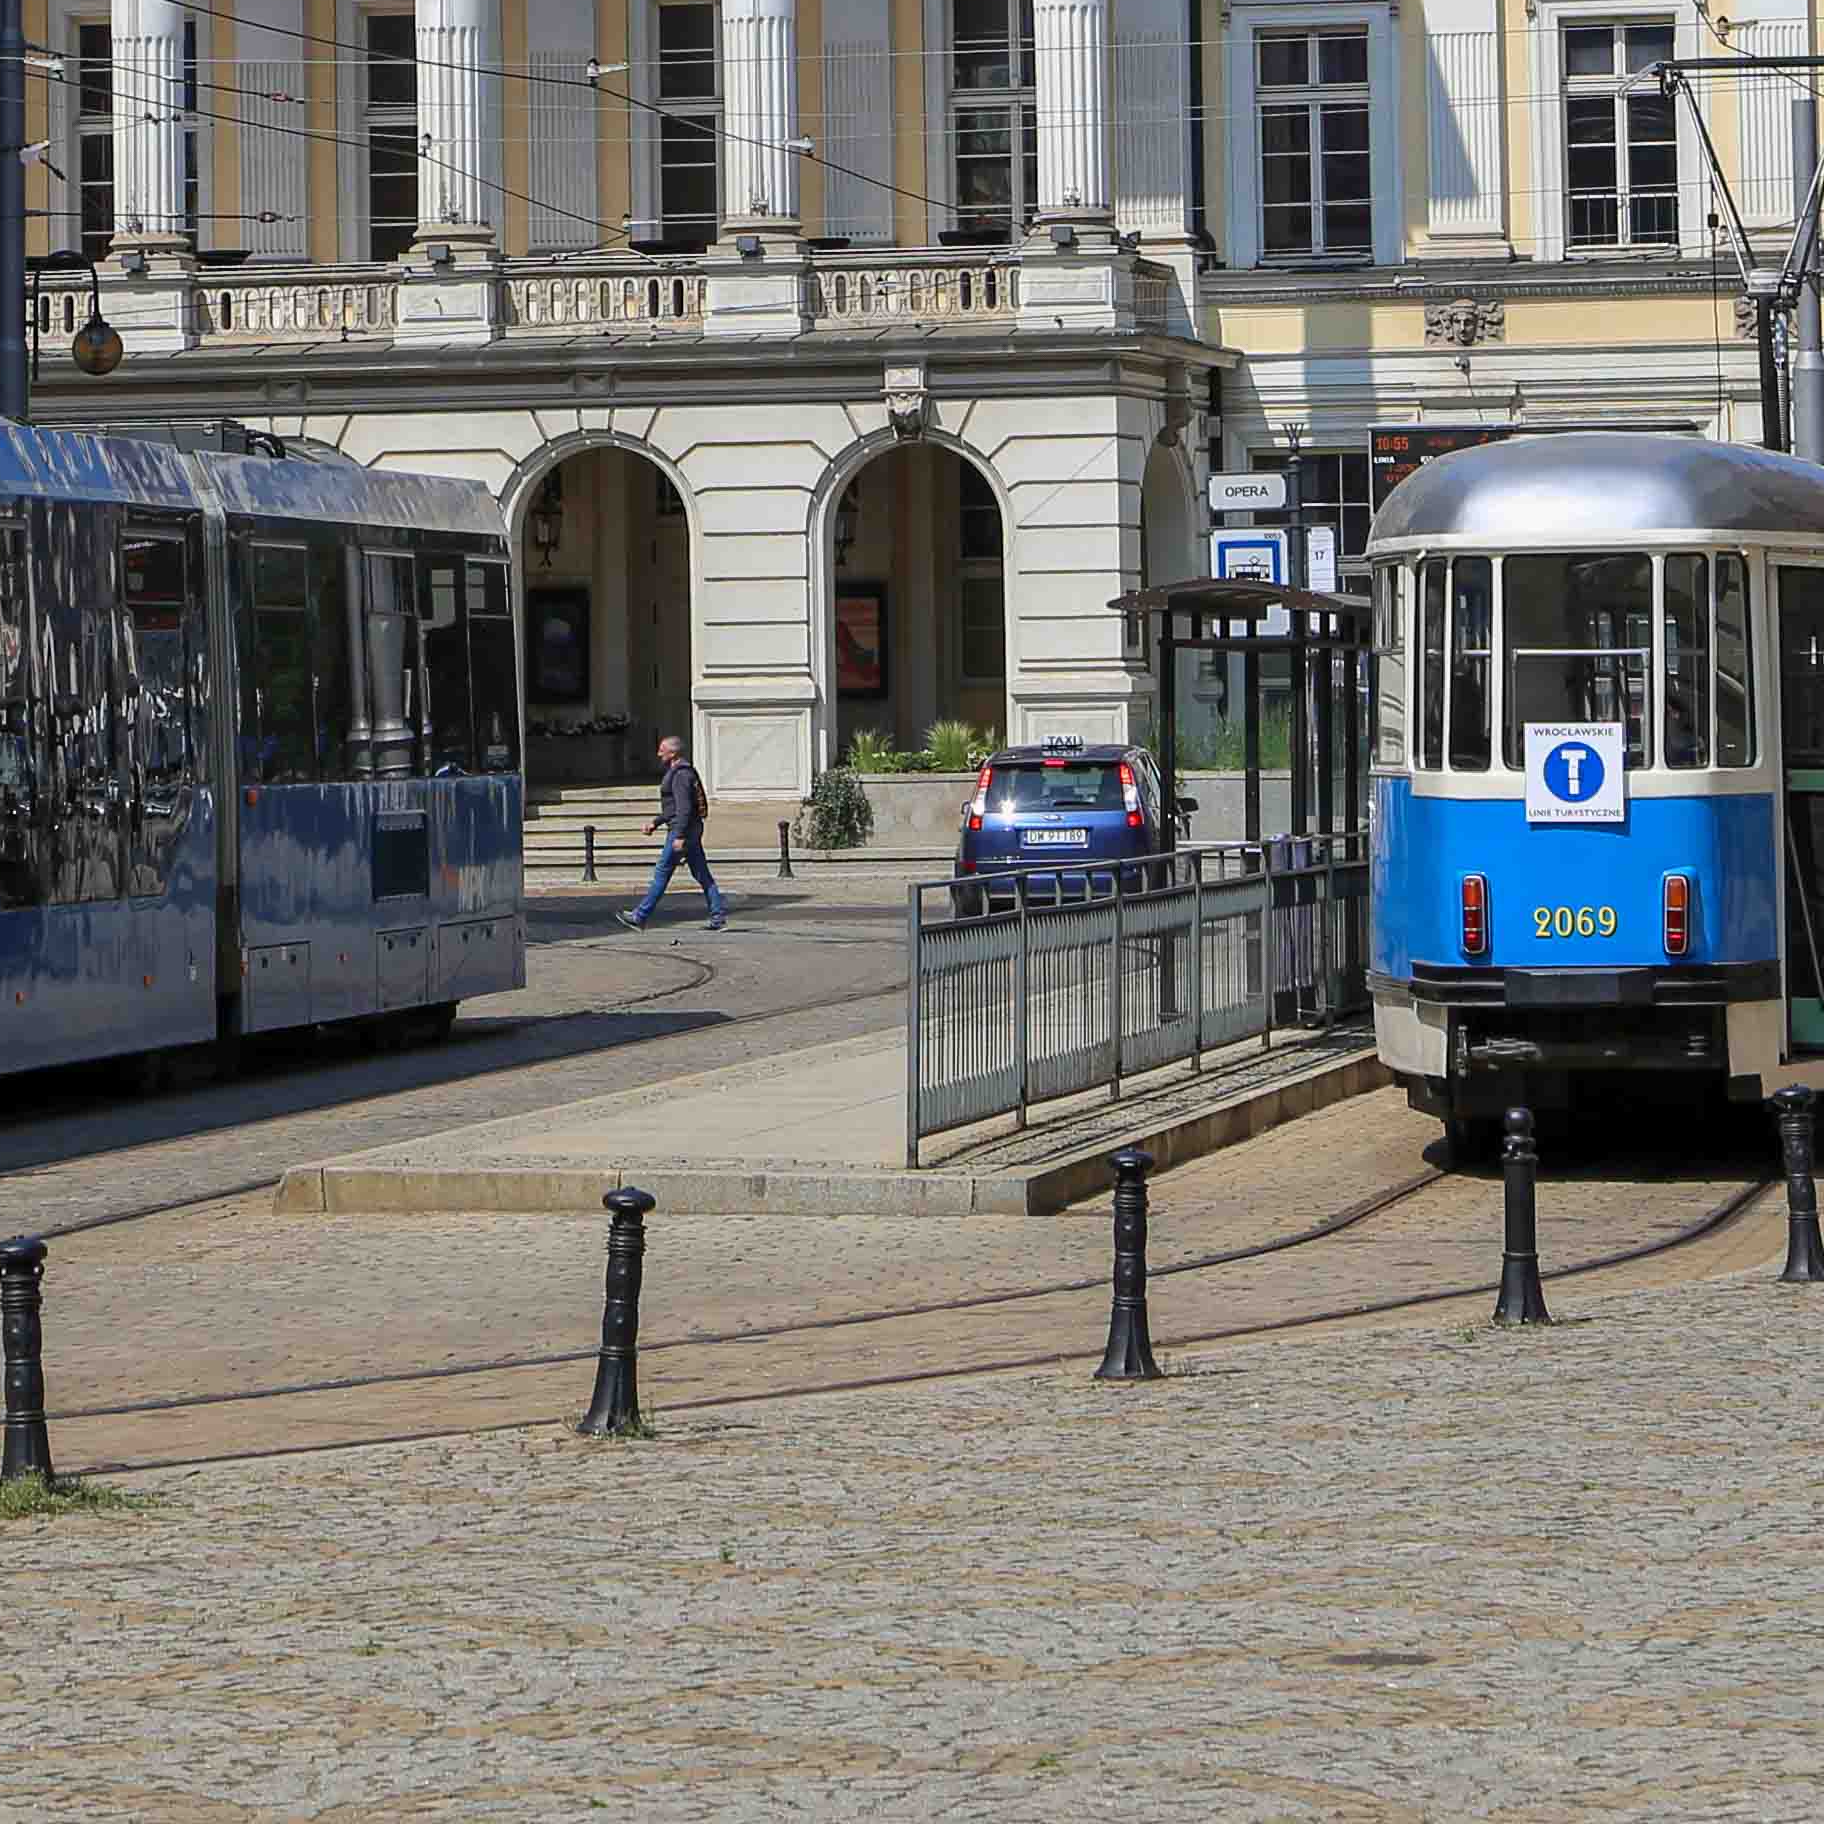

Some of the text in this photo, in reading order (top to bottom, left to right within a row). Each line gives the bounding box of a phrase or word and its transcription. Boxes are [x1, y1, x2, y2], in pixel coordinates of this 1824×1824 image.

[1224, 486, 1269, 497] OPERA
[1534, 727, 1614, 737] WROCŁAWSKIE
[1047, 736, 1078, 745] TAXI
[1529, 808, 1621, 817] LINIE TURYSTYCZNE
[1533, 905, 1617, 938] 2069
